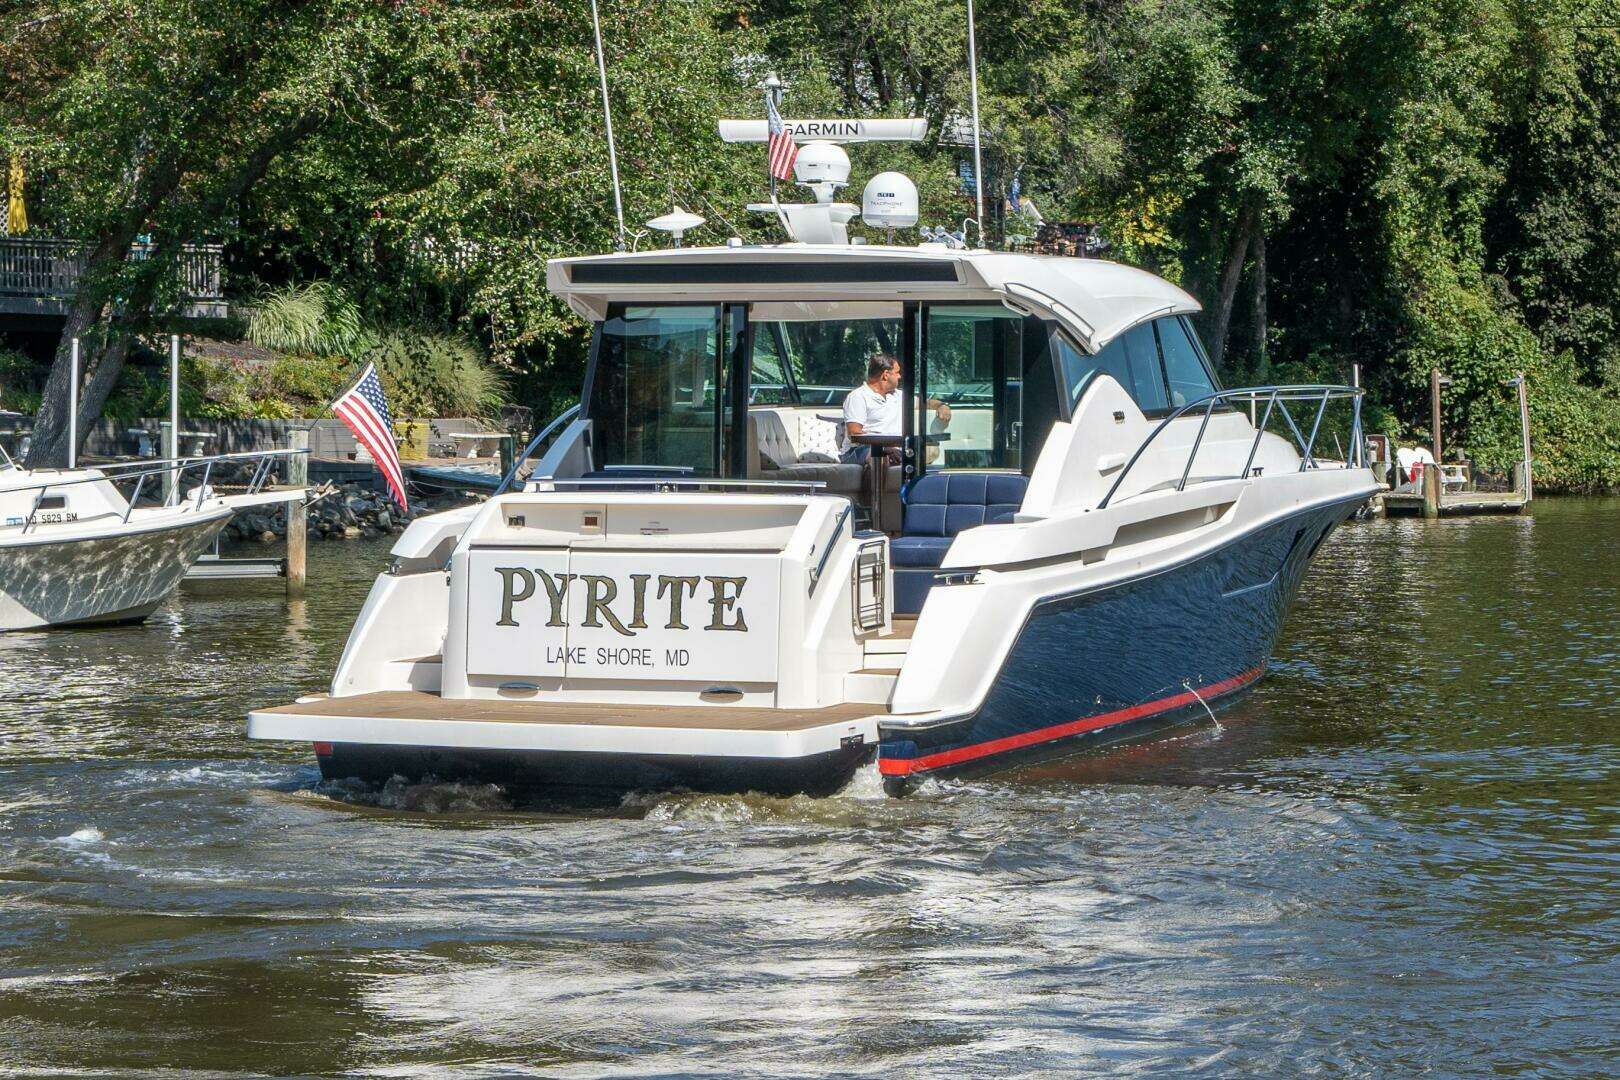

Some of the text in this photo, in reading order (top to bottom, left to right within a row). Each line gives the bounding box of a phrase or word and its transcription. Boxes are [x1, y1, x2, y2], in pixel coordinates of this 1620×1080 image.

[495, 567, 748, 636] PYRITE
[546, 647, 690, 667] LAKE SHORE, MD
